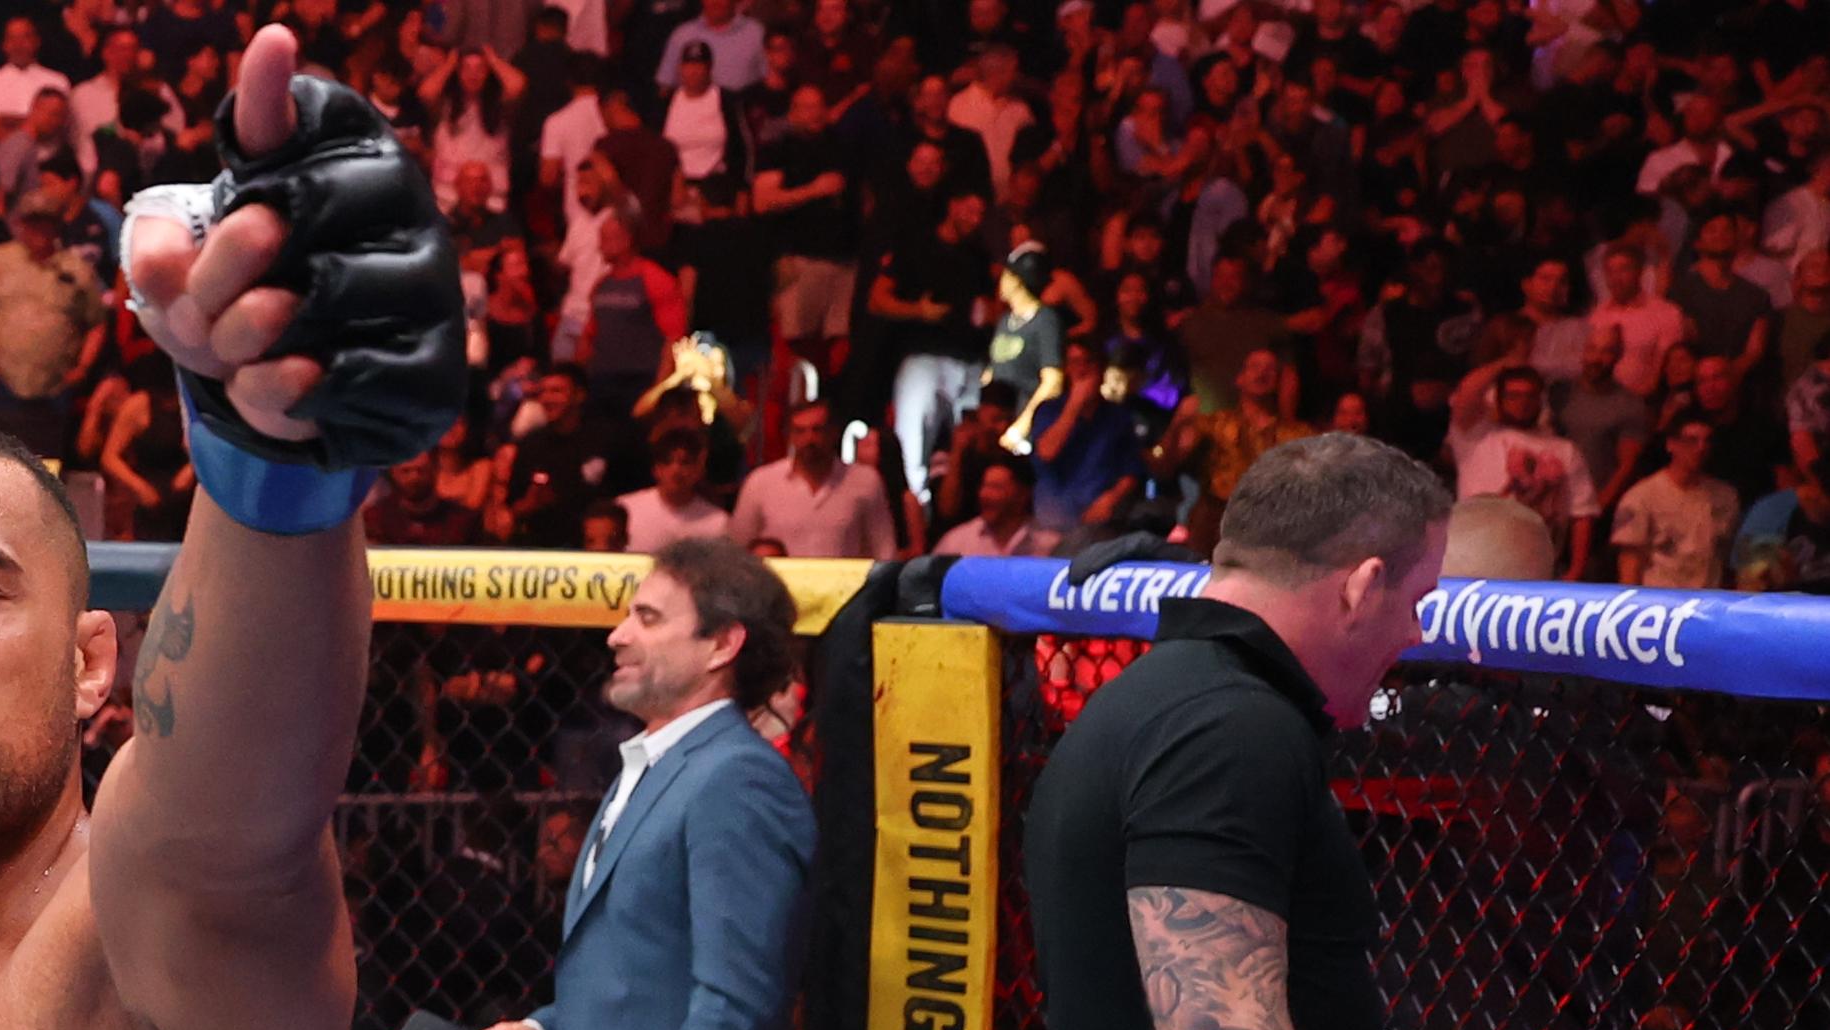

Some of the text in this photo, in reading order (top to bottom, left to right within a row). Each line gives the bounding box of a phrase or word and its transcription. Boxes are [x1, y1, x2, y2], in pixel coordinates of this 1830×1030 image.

[371, 566, 578, 601] OTHING STOPS
[1416, 580, 1701, 666] olymarket
